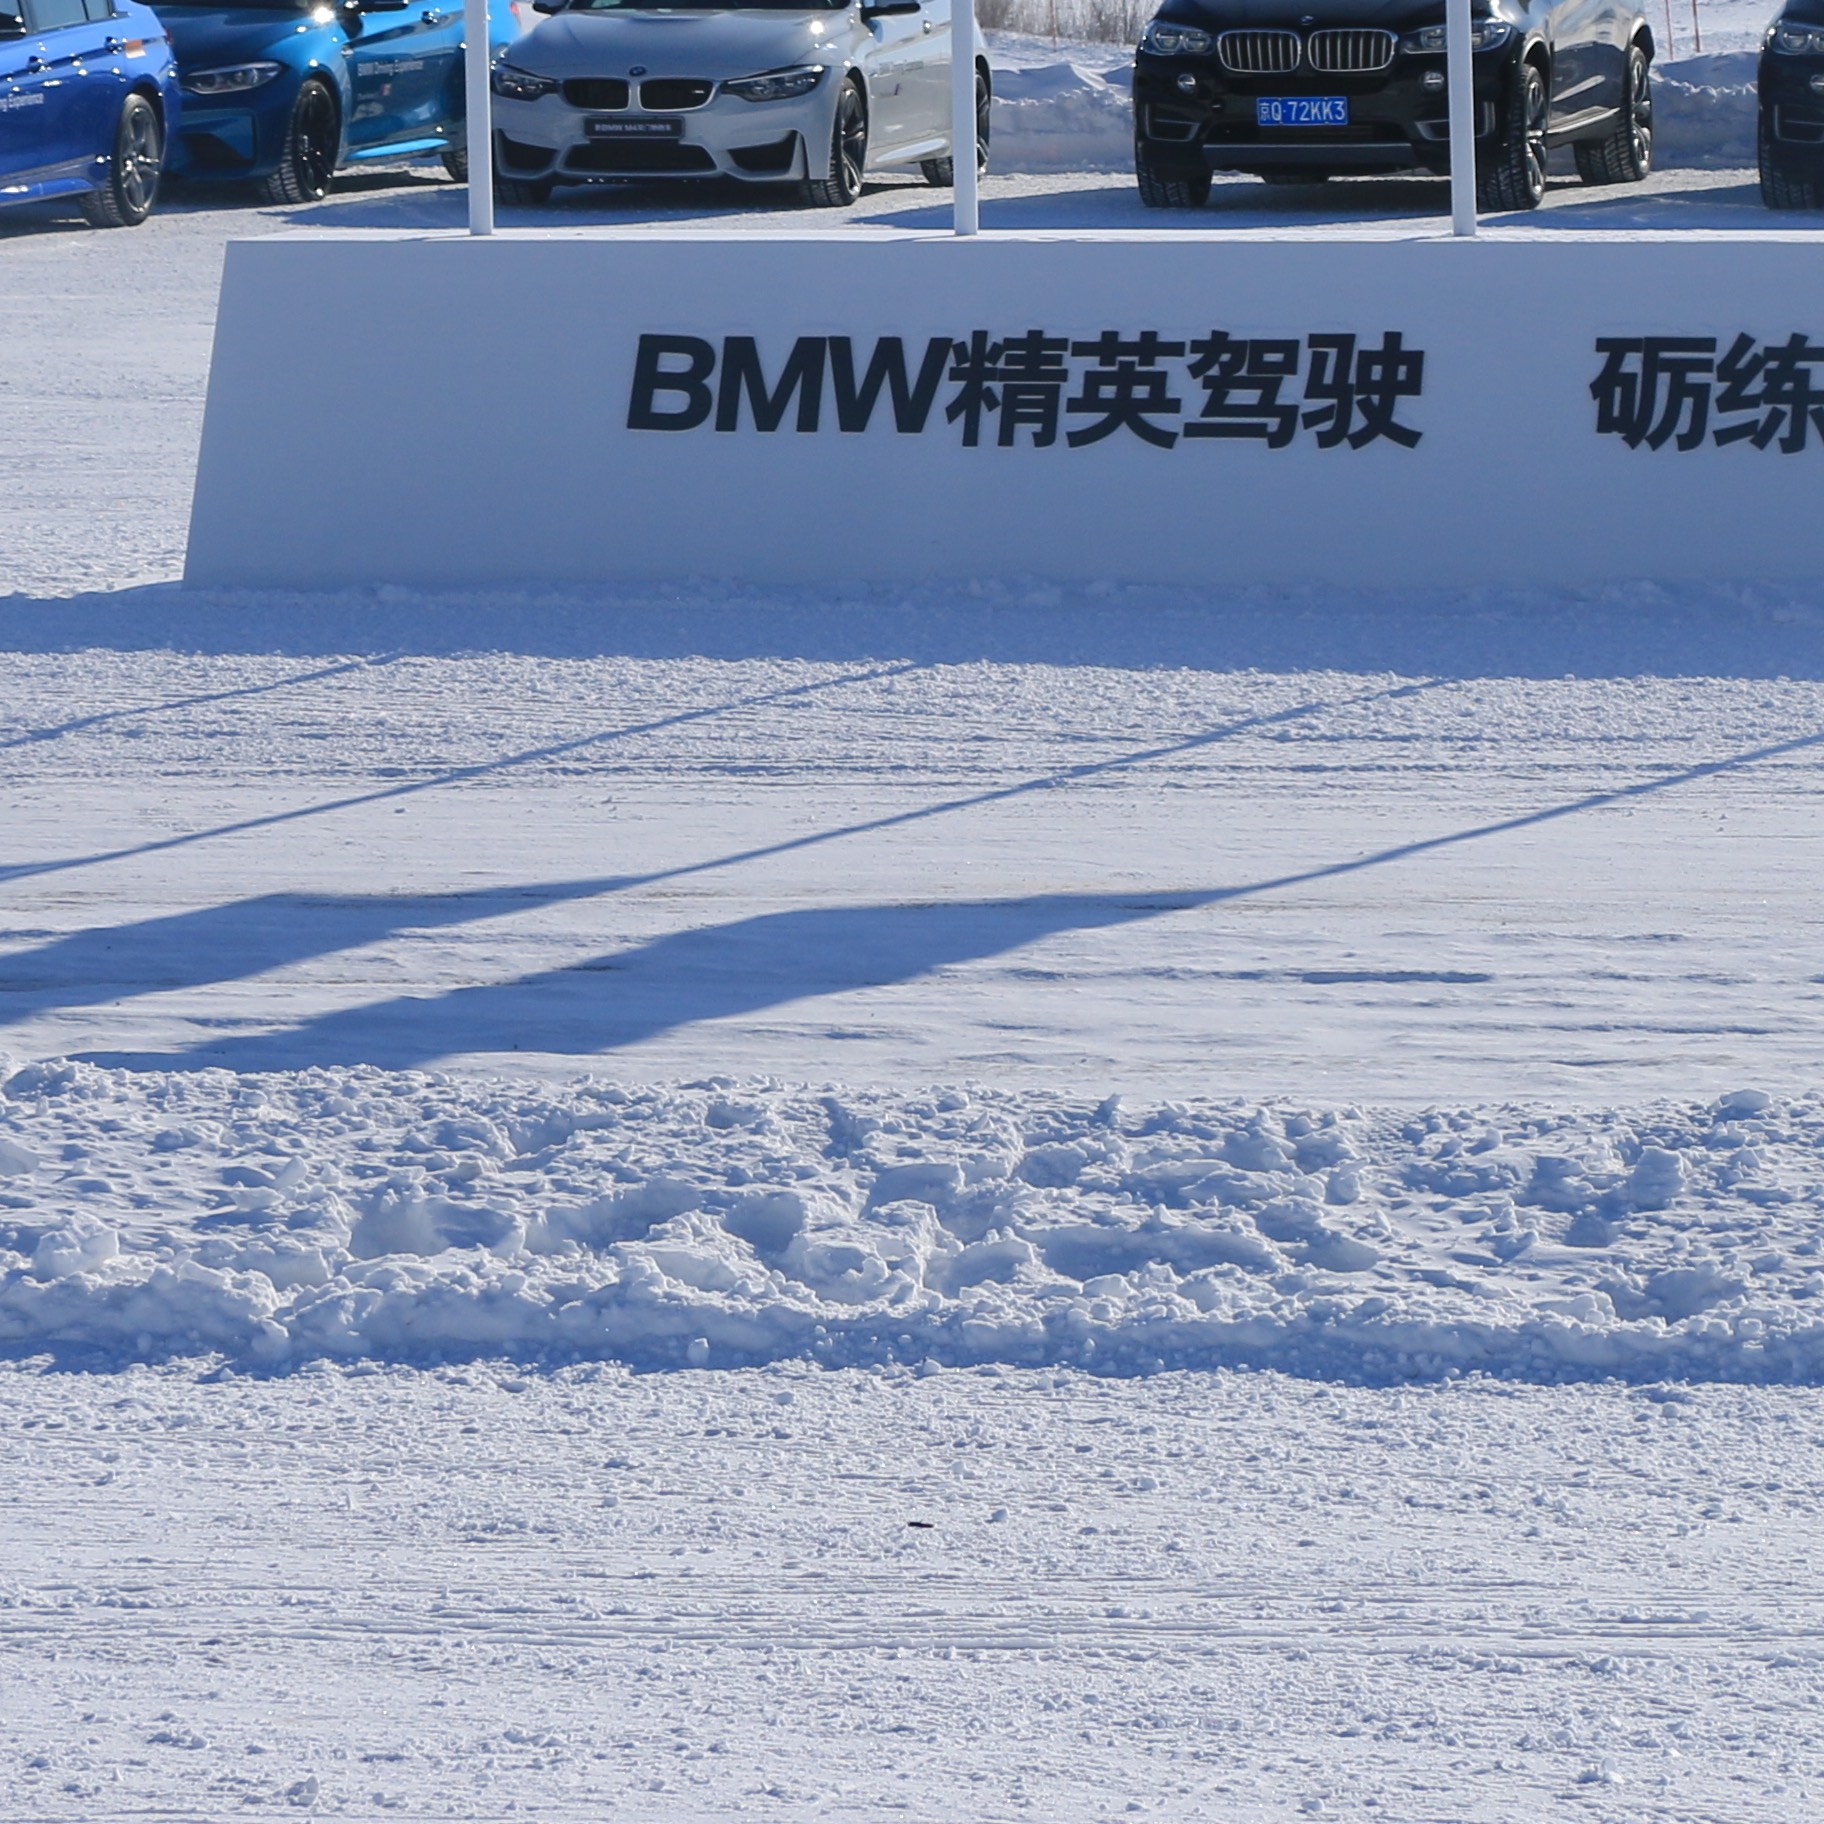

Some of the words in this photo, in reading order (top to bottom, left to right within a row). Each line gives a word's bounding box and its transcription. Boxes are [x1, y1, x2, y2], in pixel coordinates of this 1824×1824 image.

[1258, 100, 1347, 122] 京Q·72KK3
[626, 329, 1425, 451] BMW精英驾驶
